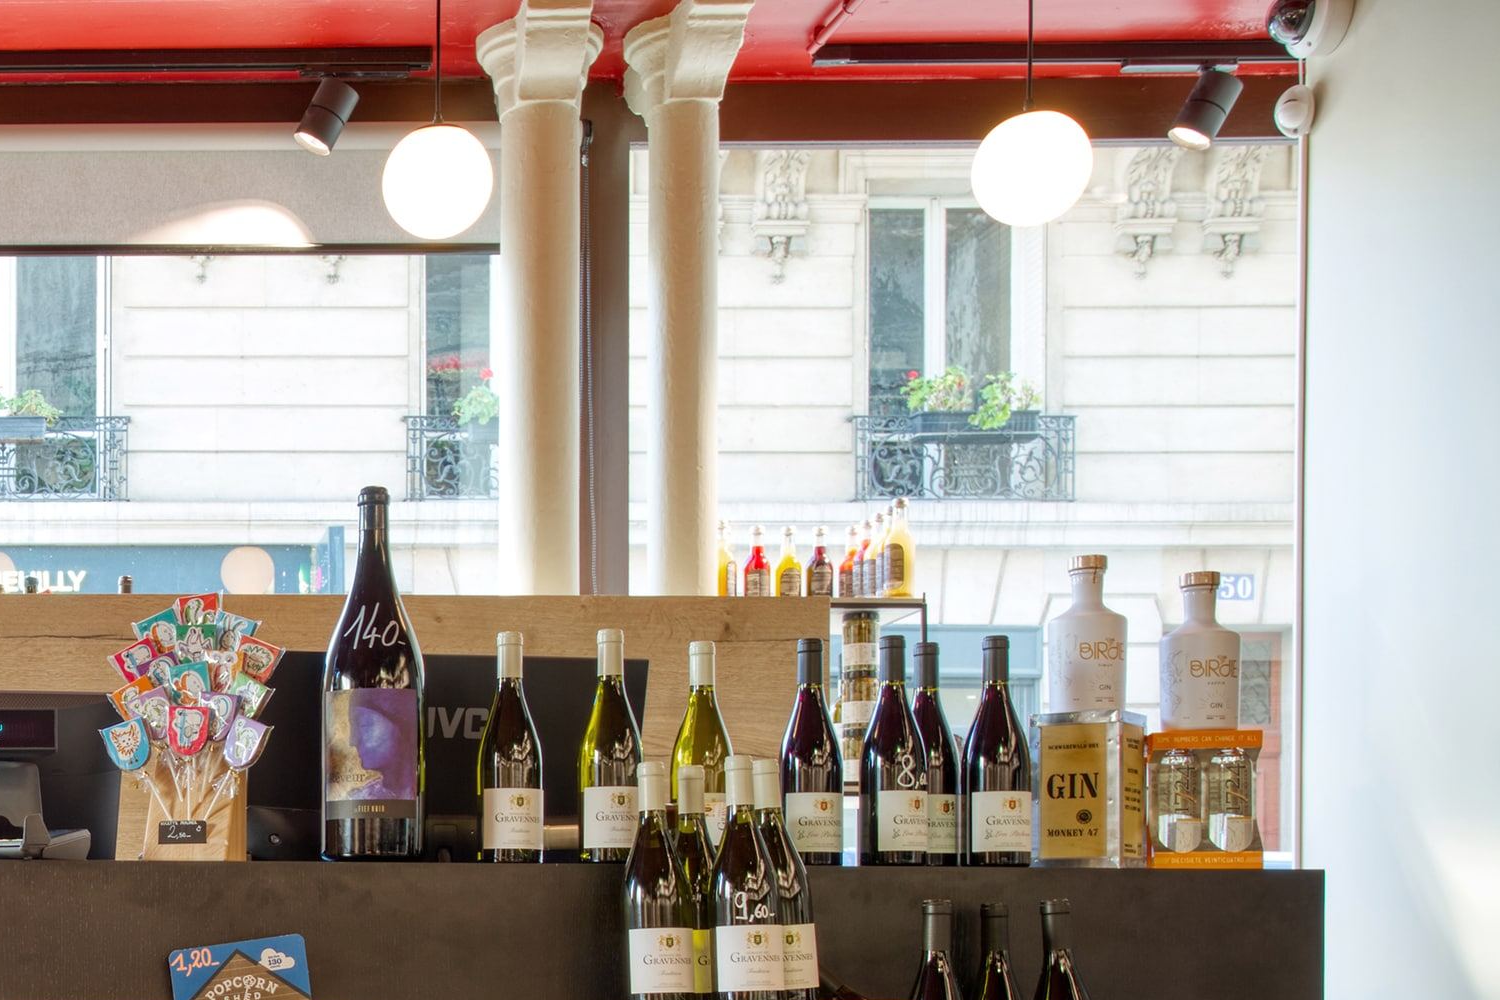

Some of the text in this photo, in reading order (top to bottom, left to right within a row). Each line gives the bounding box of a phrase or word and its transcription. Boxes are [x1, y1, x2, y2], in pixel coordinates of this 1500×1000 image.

[1220, 576, 1252, 598] 50
[1047, 772, 1099, 799] GIN
[1174, 765, 1196, 811] 1724
[1226, 764, 1248, 810] 1724
[1047, 828, 1098, 837] MONKEY 47
